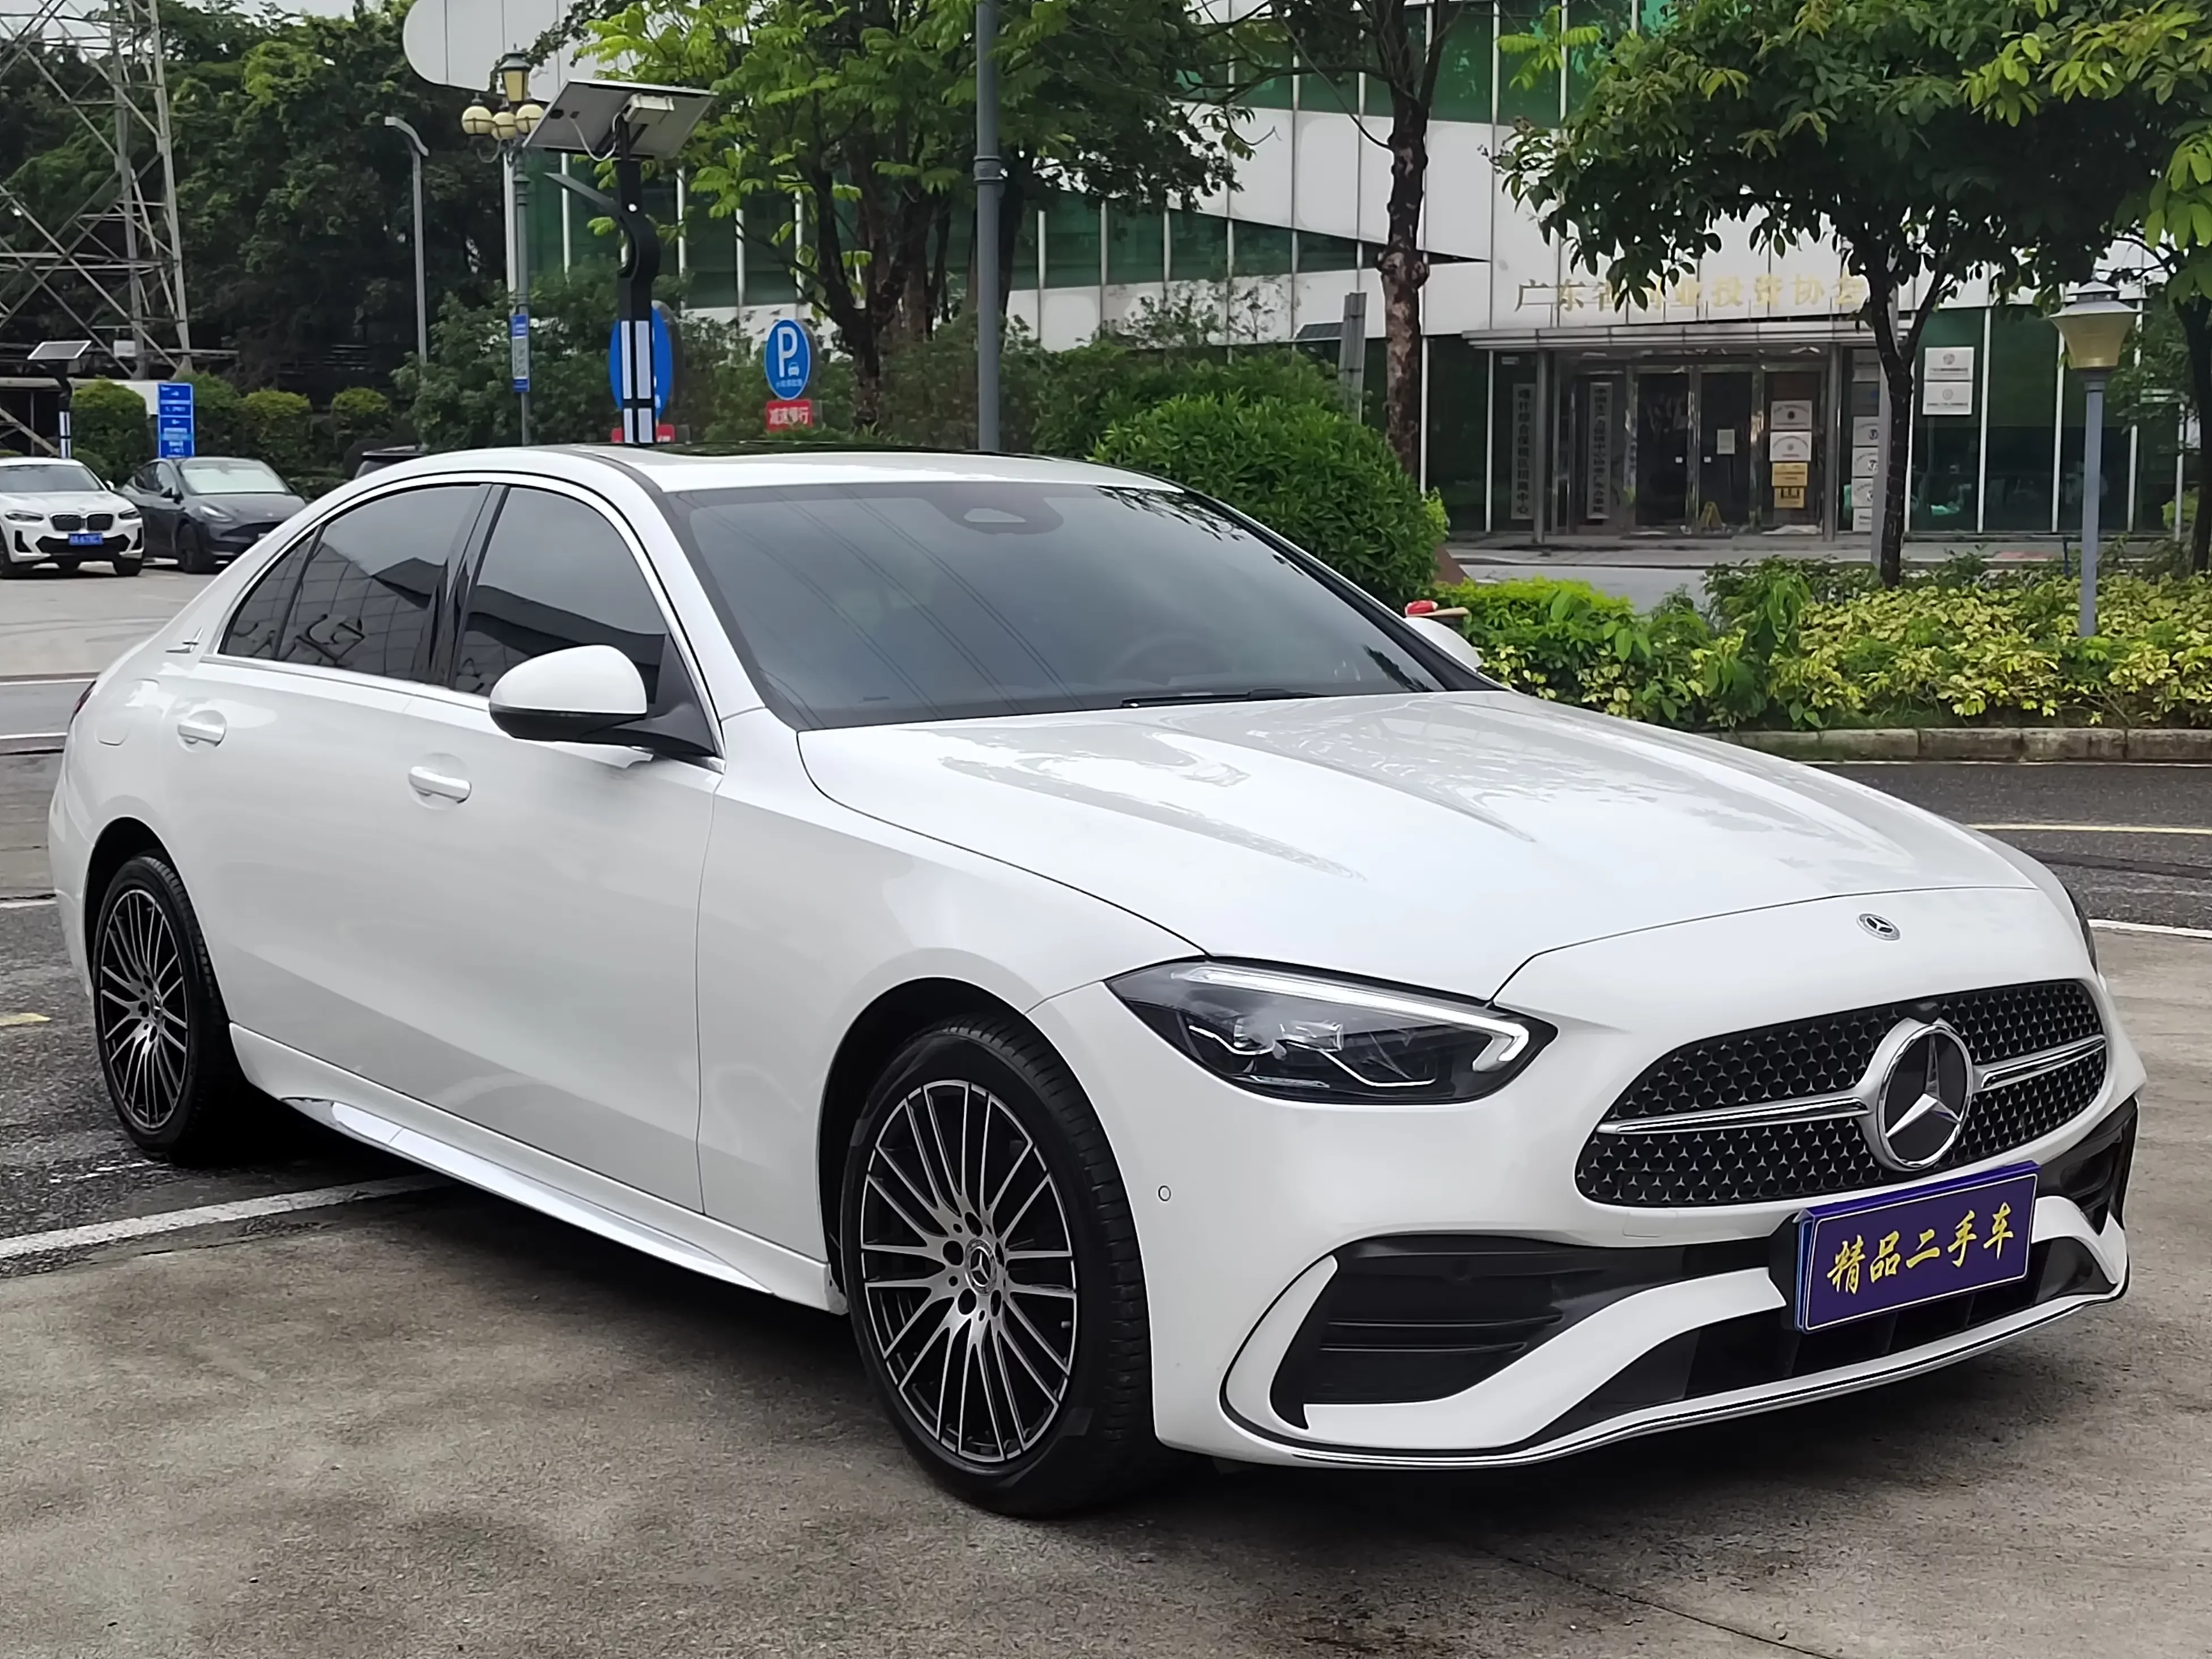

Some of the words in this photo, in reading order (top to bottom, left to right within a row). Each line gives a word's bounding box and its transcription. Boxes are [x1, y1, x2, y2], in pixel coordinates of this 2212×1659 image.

[777, 326, 798, 378] P
[1827, 1202, 2015, 1295] 精品二手车
